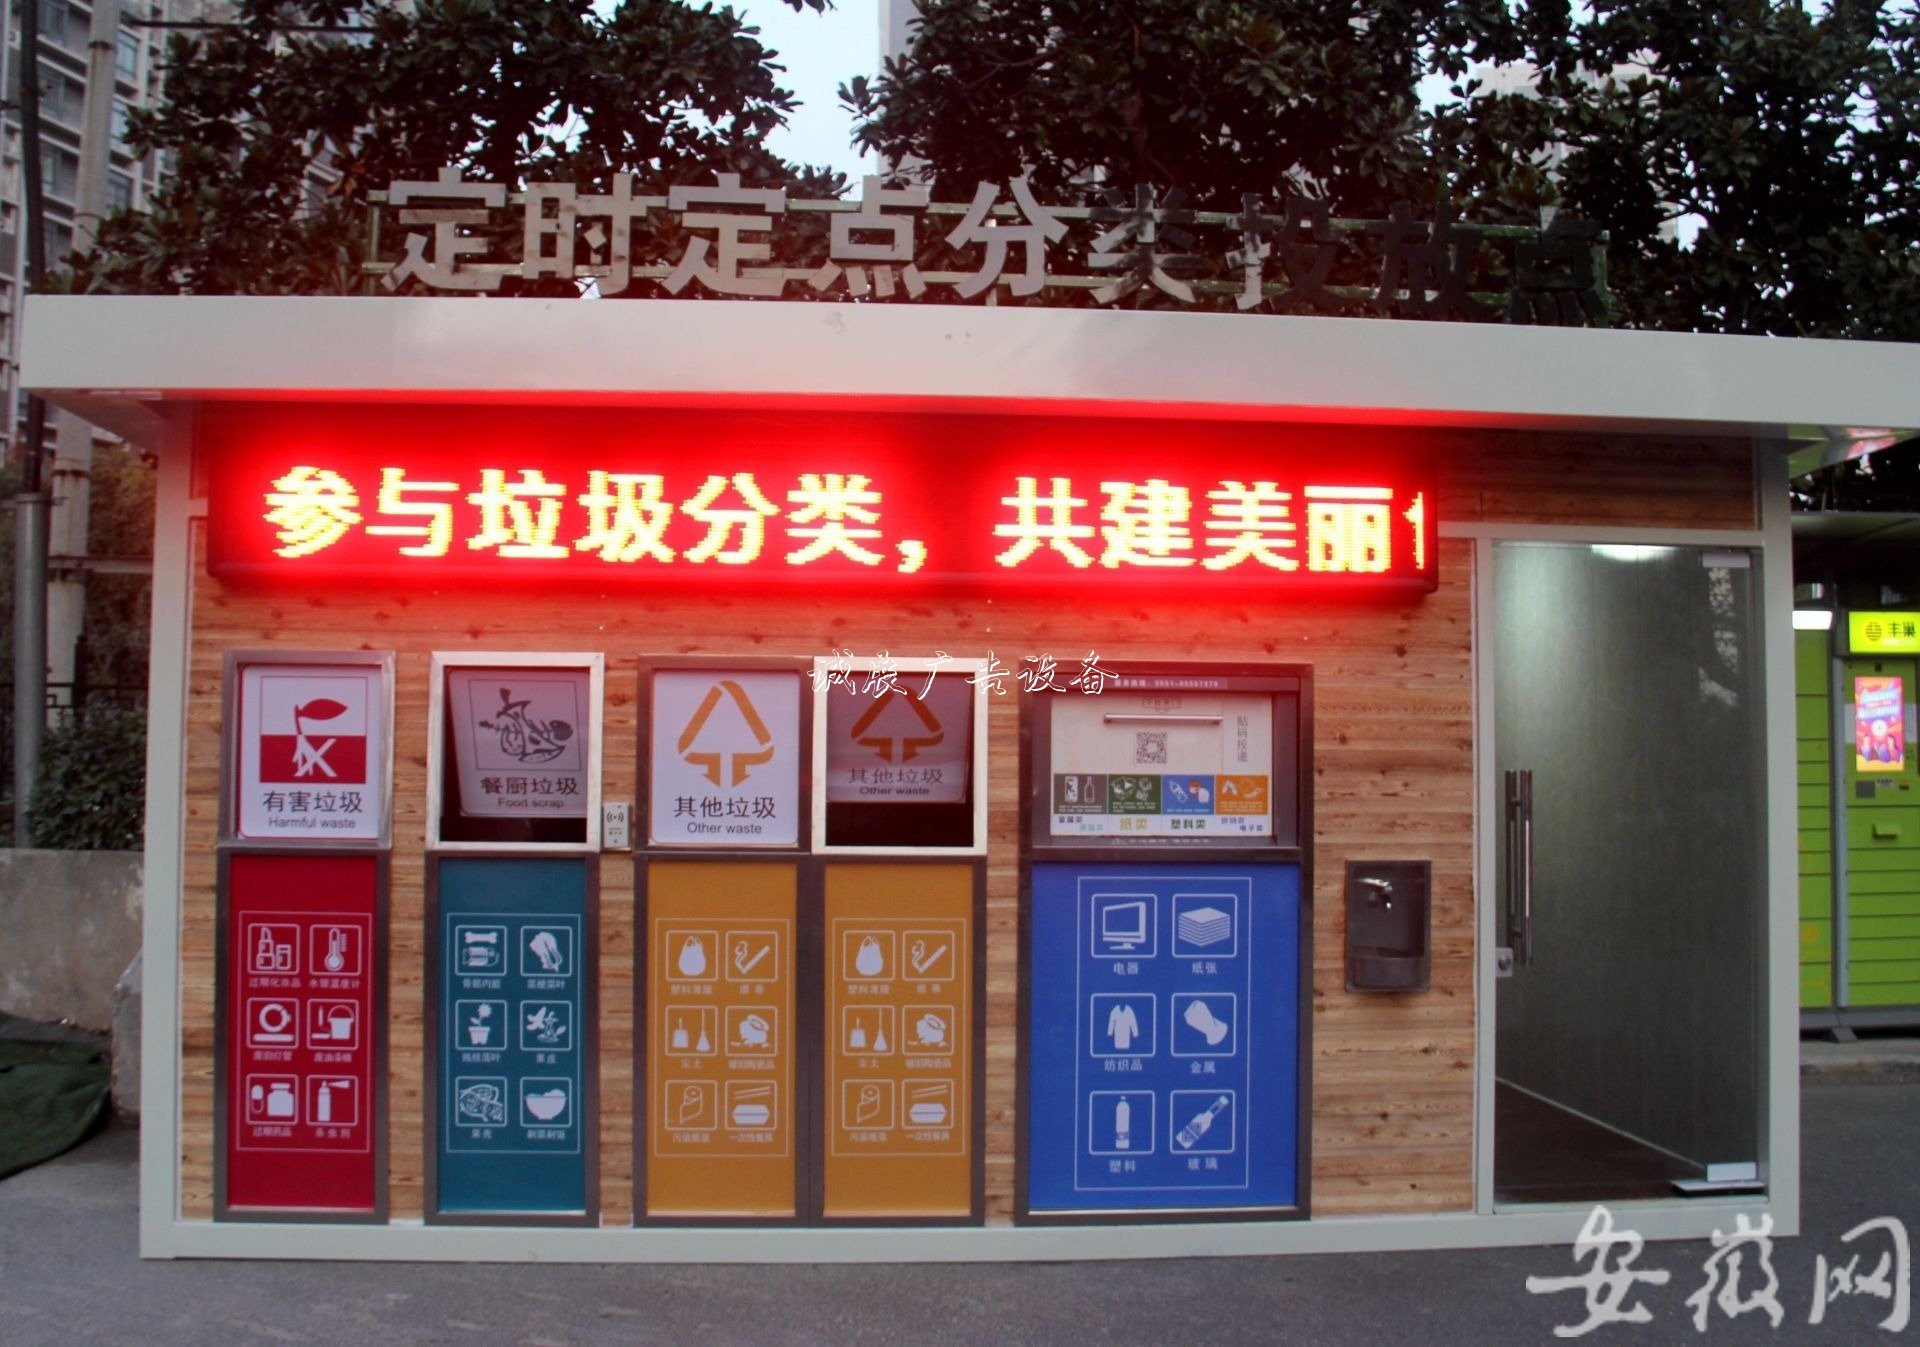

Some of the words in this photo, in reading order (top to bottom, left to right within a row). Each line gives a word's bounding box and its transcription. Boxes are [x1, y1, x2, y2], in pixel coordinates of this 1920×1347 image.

[380, 166, 1612, 327] 定时定点分类投放点
[1888, 620, 1916, 638] 丰巢
[847, 767, 944, 785] 其他垃圾
[480, 776, 579, 796] 餐厨垃圾
[859, 786, 893, 796] Other
[895, 787, 930, 796] waste
[261, 790, 363, 814] 有害垃圾
[497, 797, 528, 808] Food
[531, 798, 565, 810] scrap
[673, 795, 776, 819] 其他垃圾
[268, 815, 317, 829] Harmful
[319, 818, 356, 829] waste
[686, 821, 722, 834] Other
[726, 823, 762, 834] waste
[1113, 962, 1139, 975] 电器
[1191, 961, 1218, 975] 纸张
[1104, 1059, 1142, 1072] 纺织品
[1190, 1061, 1216, 1074] 金属
[1109, 1159, 1136, 1173] 塑料
[1187, 1157, 1218, 1170] 玻璃
